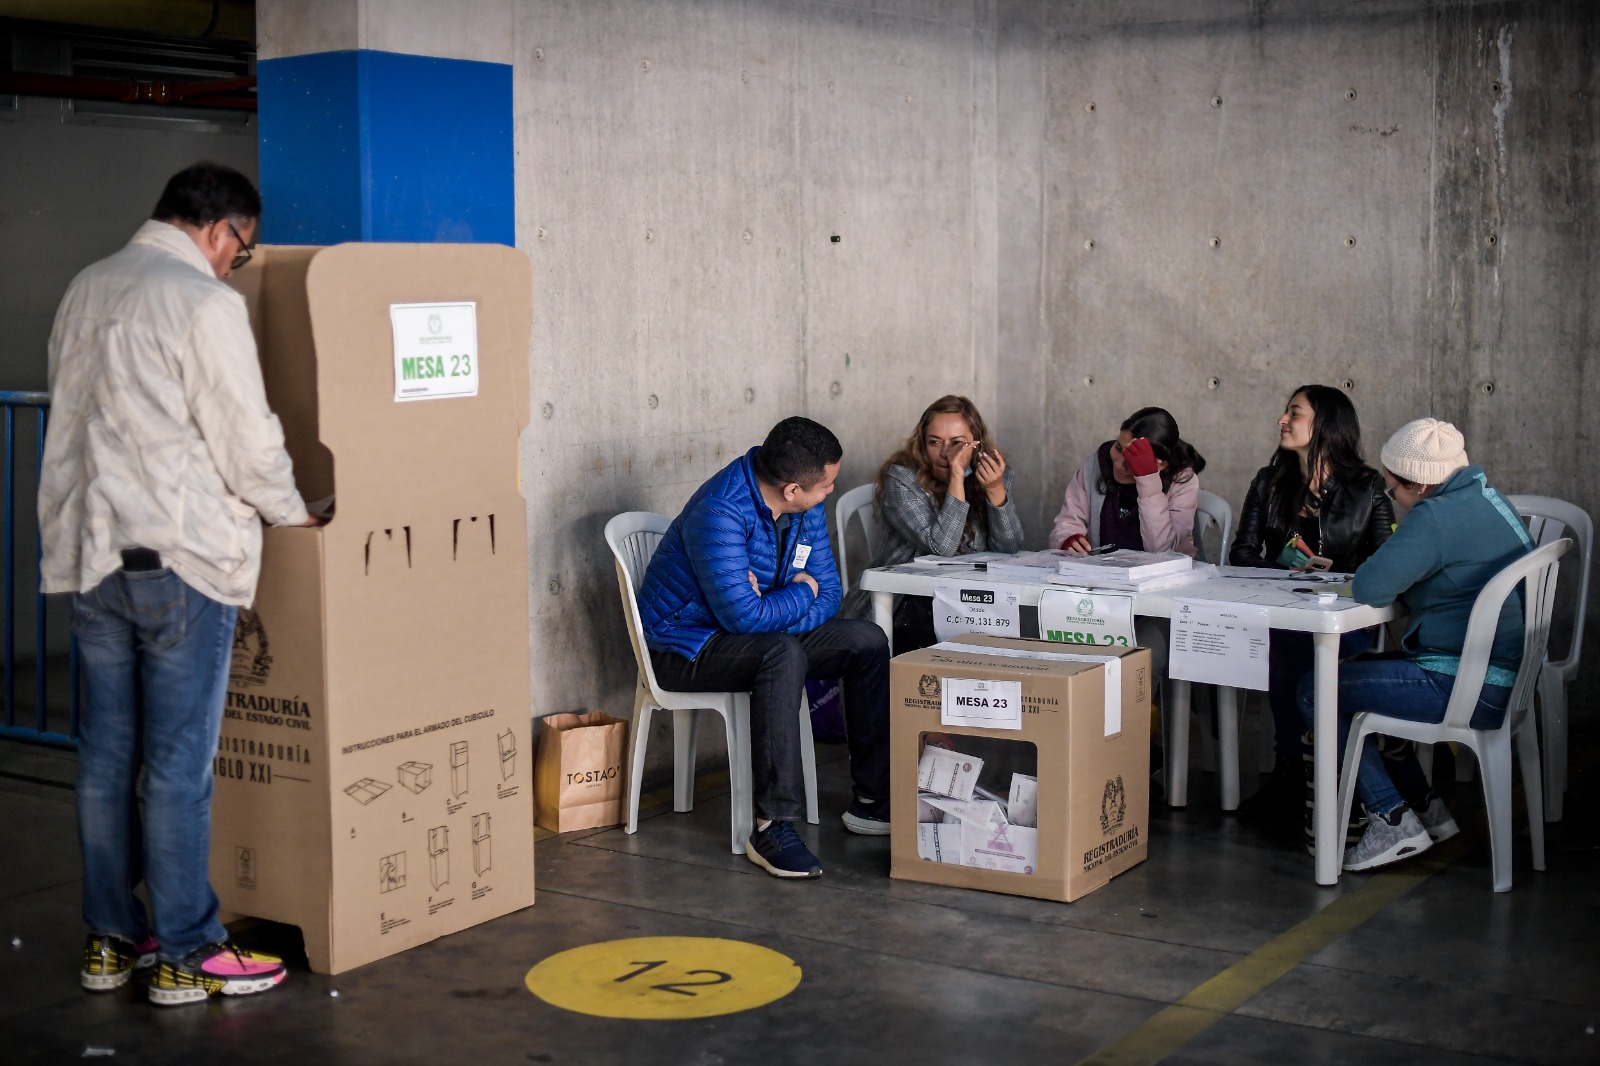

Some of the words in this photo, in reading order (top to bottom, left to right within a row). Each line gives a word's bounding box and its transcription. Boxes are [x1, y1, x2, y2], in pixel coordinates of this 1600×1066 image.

[402, 355, 445, 380] MESA
[451, 353, 471, 376] 23
[962, 593, 981, 602] Mesa
[984, 595, 993, 603] 23
[965, 616, 1010, 627] 79.131.879
[1046, 630, 1095, 645] MESA
[226, 691, 311, 718] TRADURÍA
[904, 697, 942, 706] REGISTRAD
[956, 696, 989, 708] MESA
[993, 698, 1008, 709] 23
[1021, 696, 1059, 706] STRADURÍA
[224, 709, 243, 720] DEL
[246, 712, 284, 726] ESTADO
[286, 718, 312, 730] CIVIL
[396, 730, 413, 741] PARA
[414, 727, 423, 736] EL
[424, 720, 451, 733] ARMADO
[451, 717, 463, 727] DEL
[218, 736, 311, 764] GISTRADURÍA
[213, 756, 244, 780] IGLO
[249, 762, 272, 785] XXI
[1084, 823, 1139, 865] REGISTRADURÍA
[614, 960, 733, 997] 12
